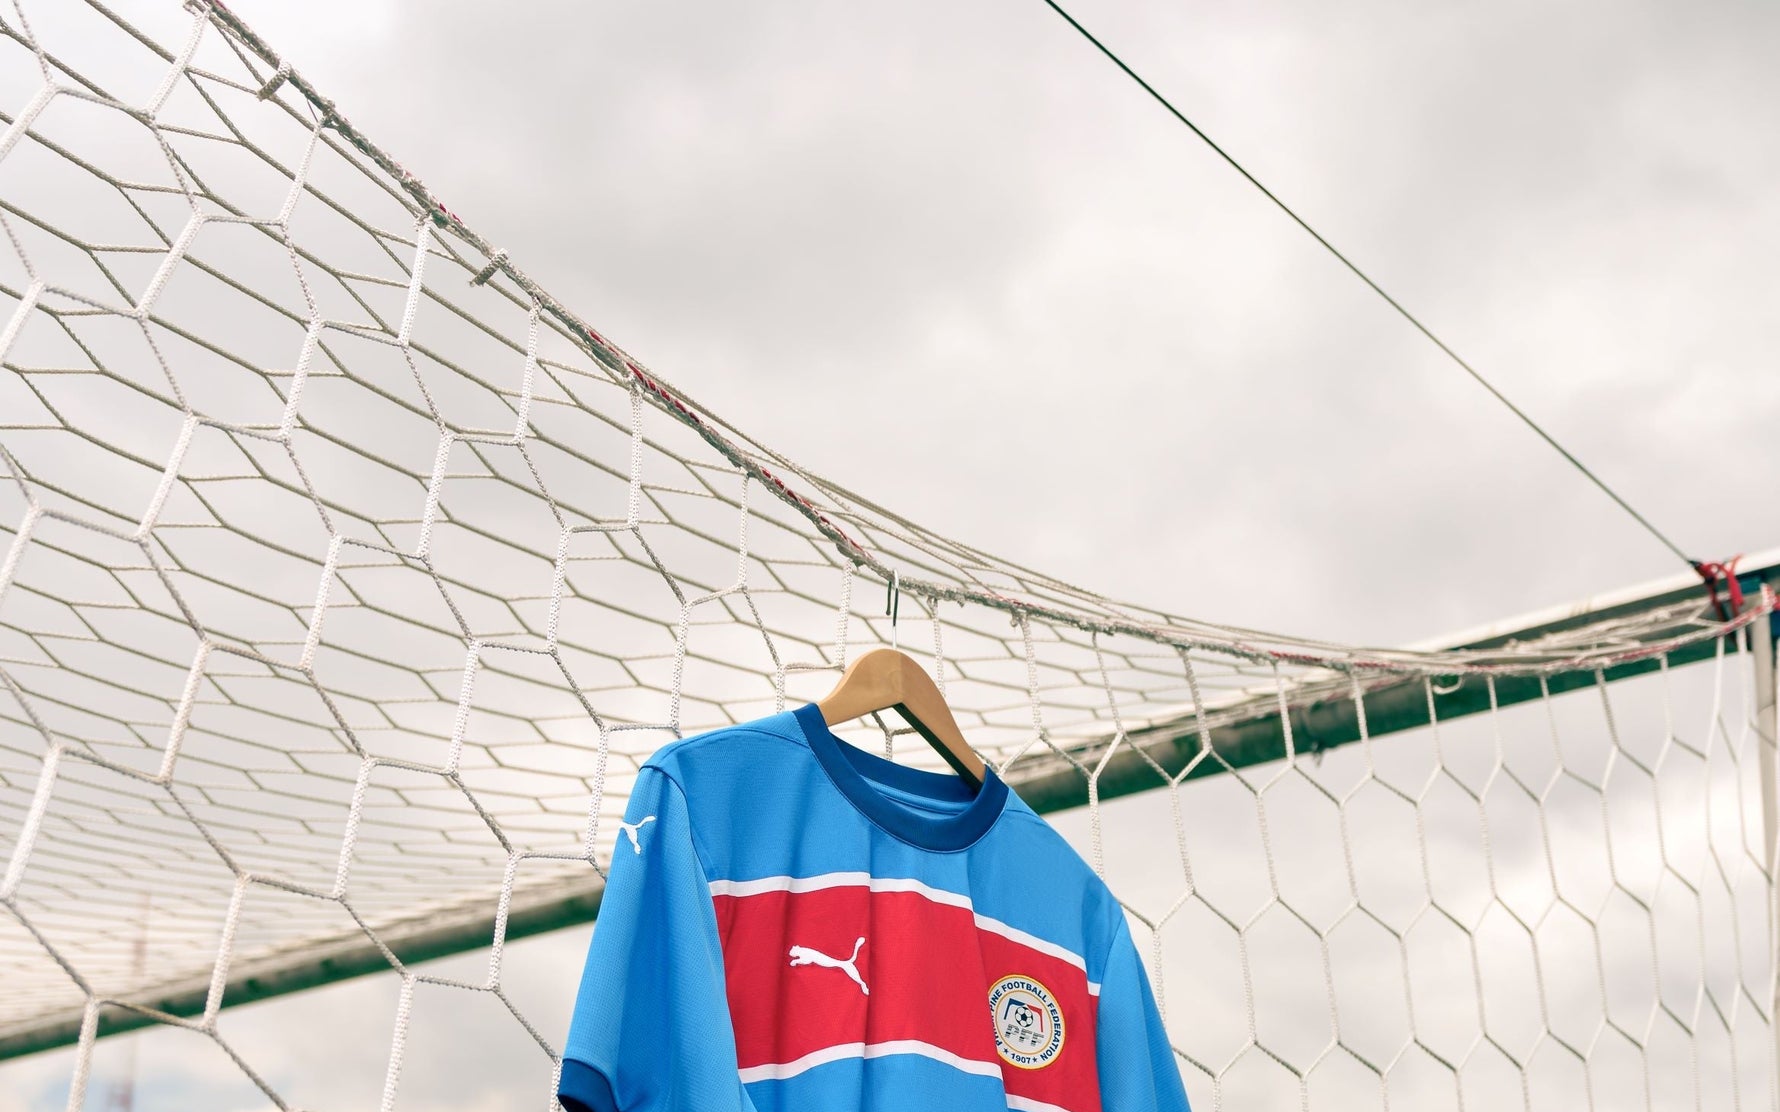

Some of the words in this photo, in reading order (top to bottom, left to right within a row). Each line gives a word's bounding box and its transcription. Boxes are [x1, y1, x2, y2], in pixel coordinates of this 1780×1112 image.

[1002, 981, 1047, 1002] FOOTBALL
[1040, 1002, 1062, 1061] FEDERATION
[1011, 1053, 1031, 1065] 1907
